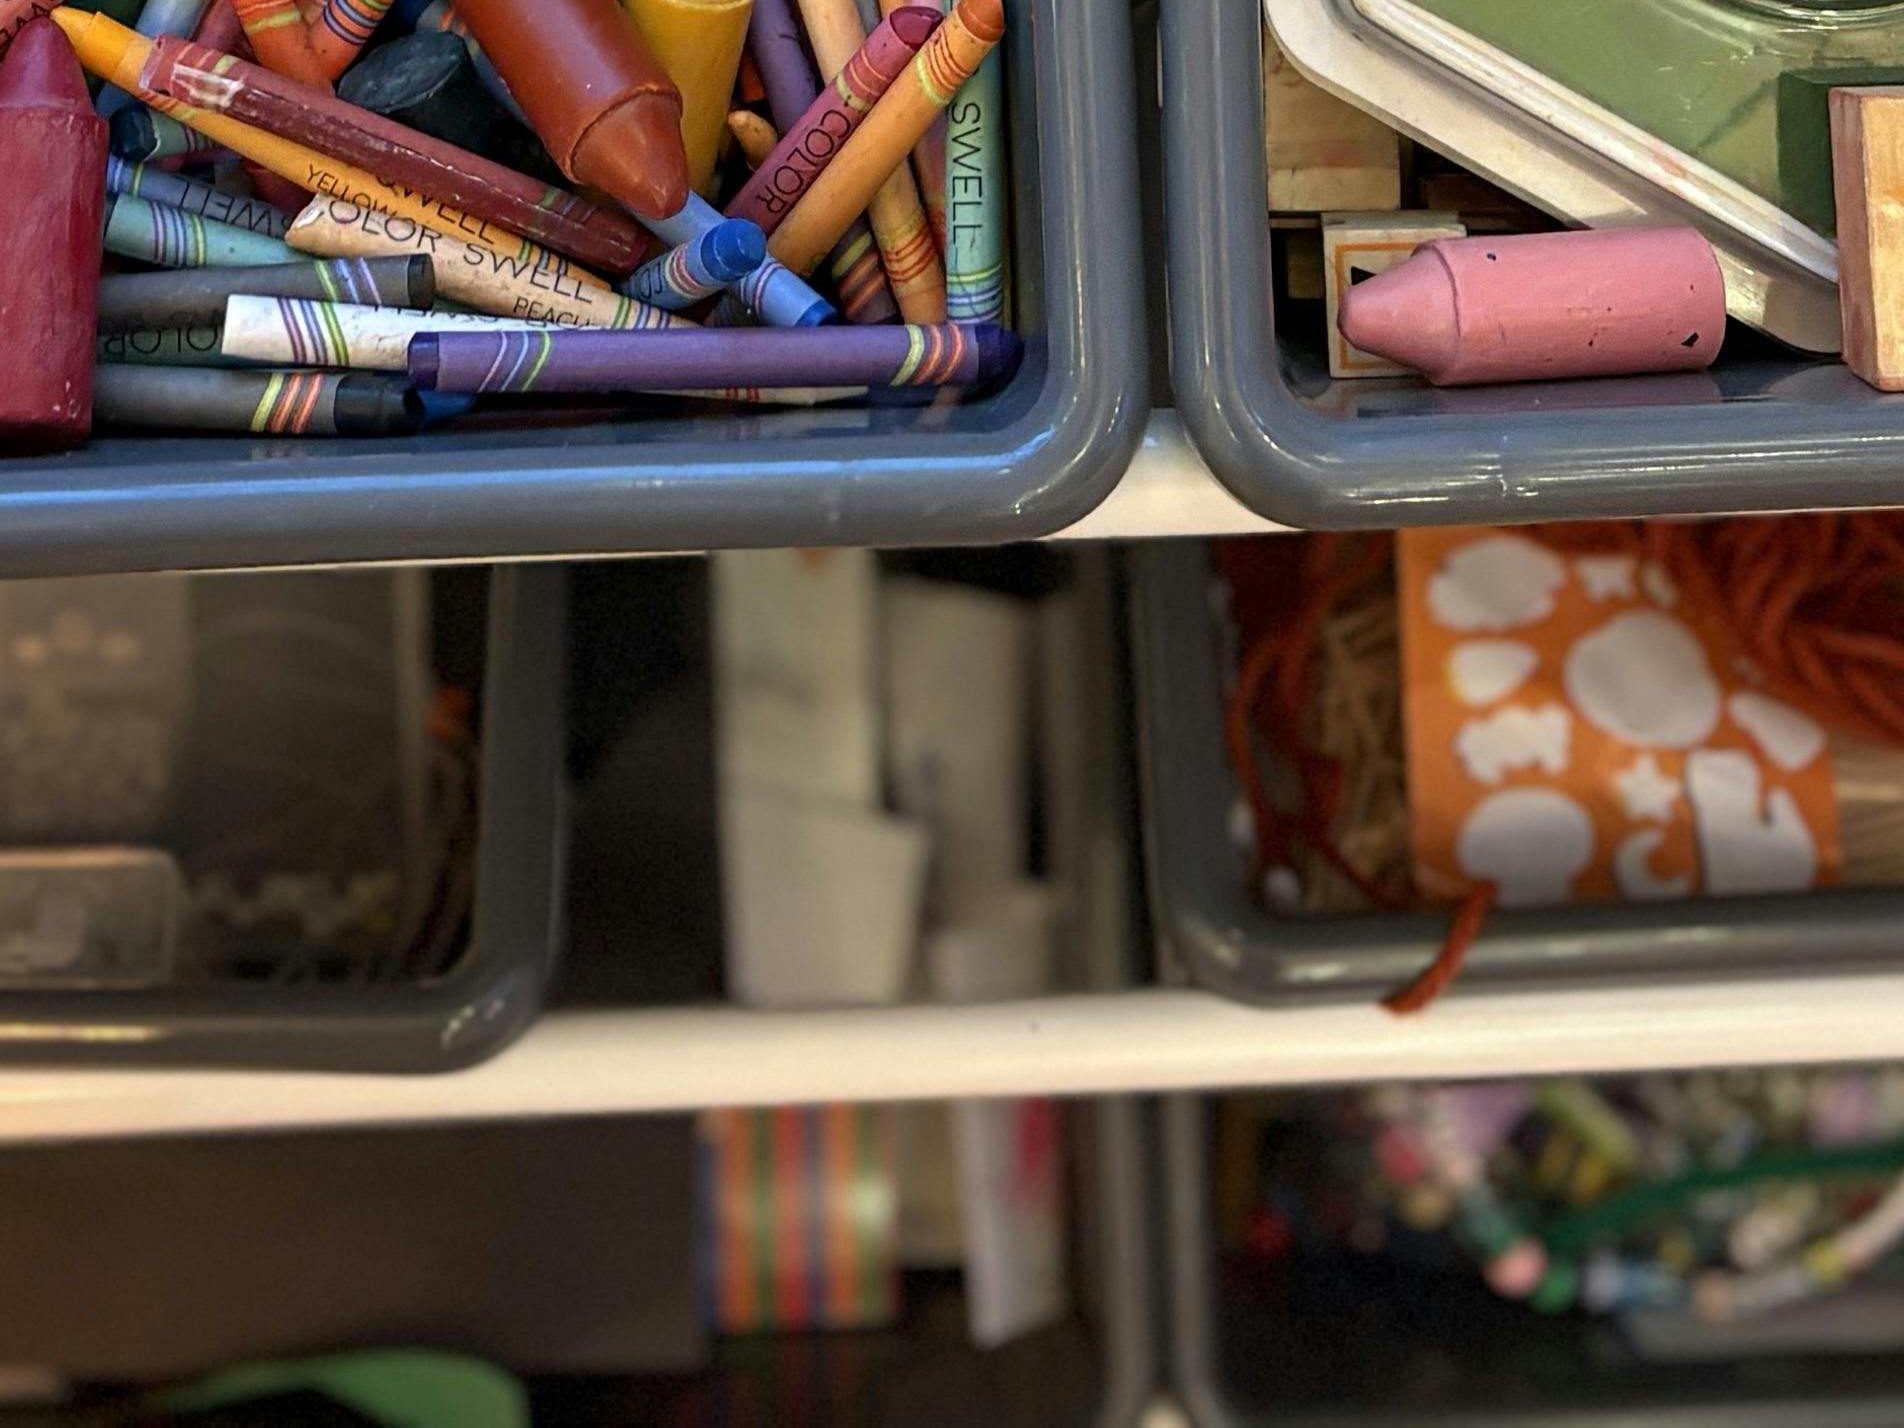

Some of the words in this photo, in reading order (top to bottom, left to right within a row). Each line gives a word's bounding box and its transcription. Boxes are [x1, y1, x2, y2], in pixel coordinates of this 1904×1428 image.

[756, 107, 851, 215] COLOR
[947, 101, 983, 244] SWELL
[326, 194, 440, 254] OLOR
[462, 240, 593, 304] SWELL
